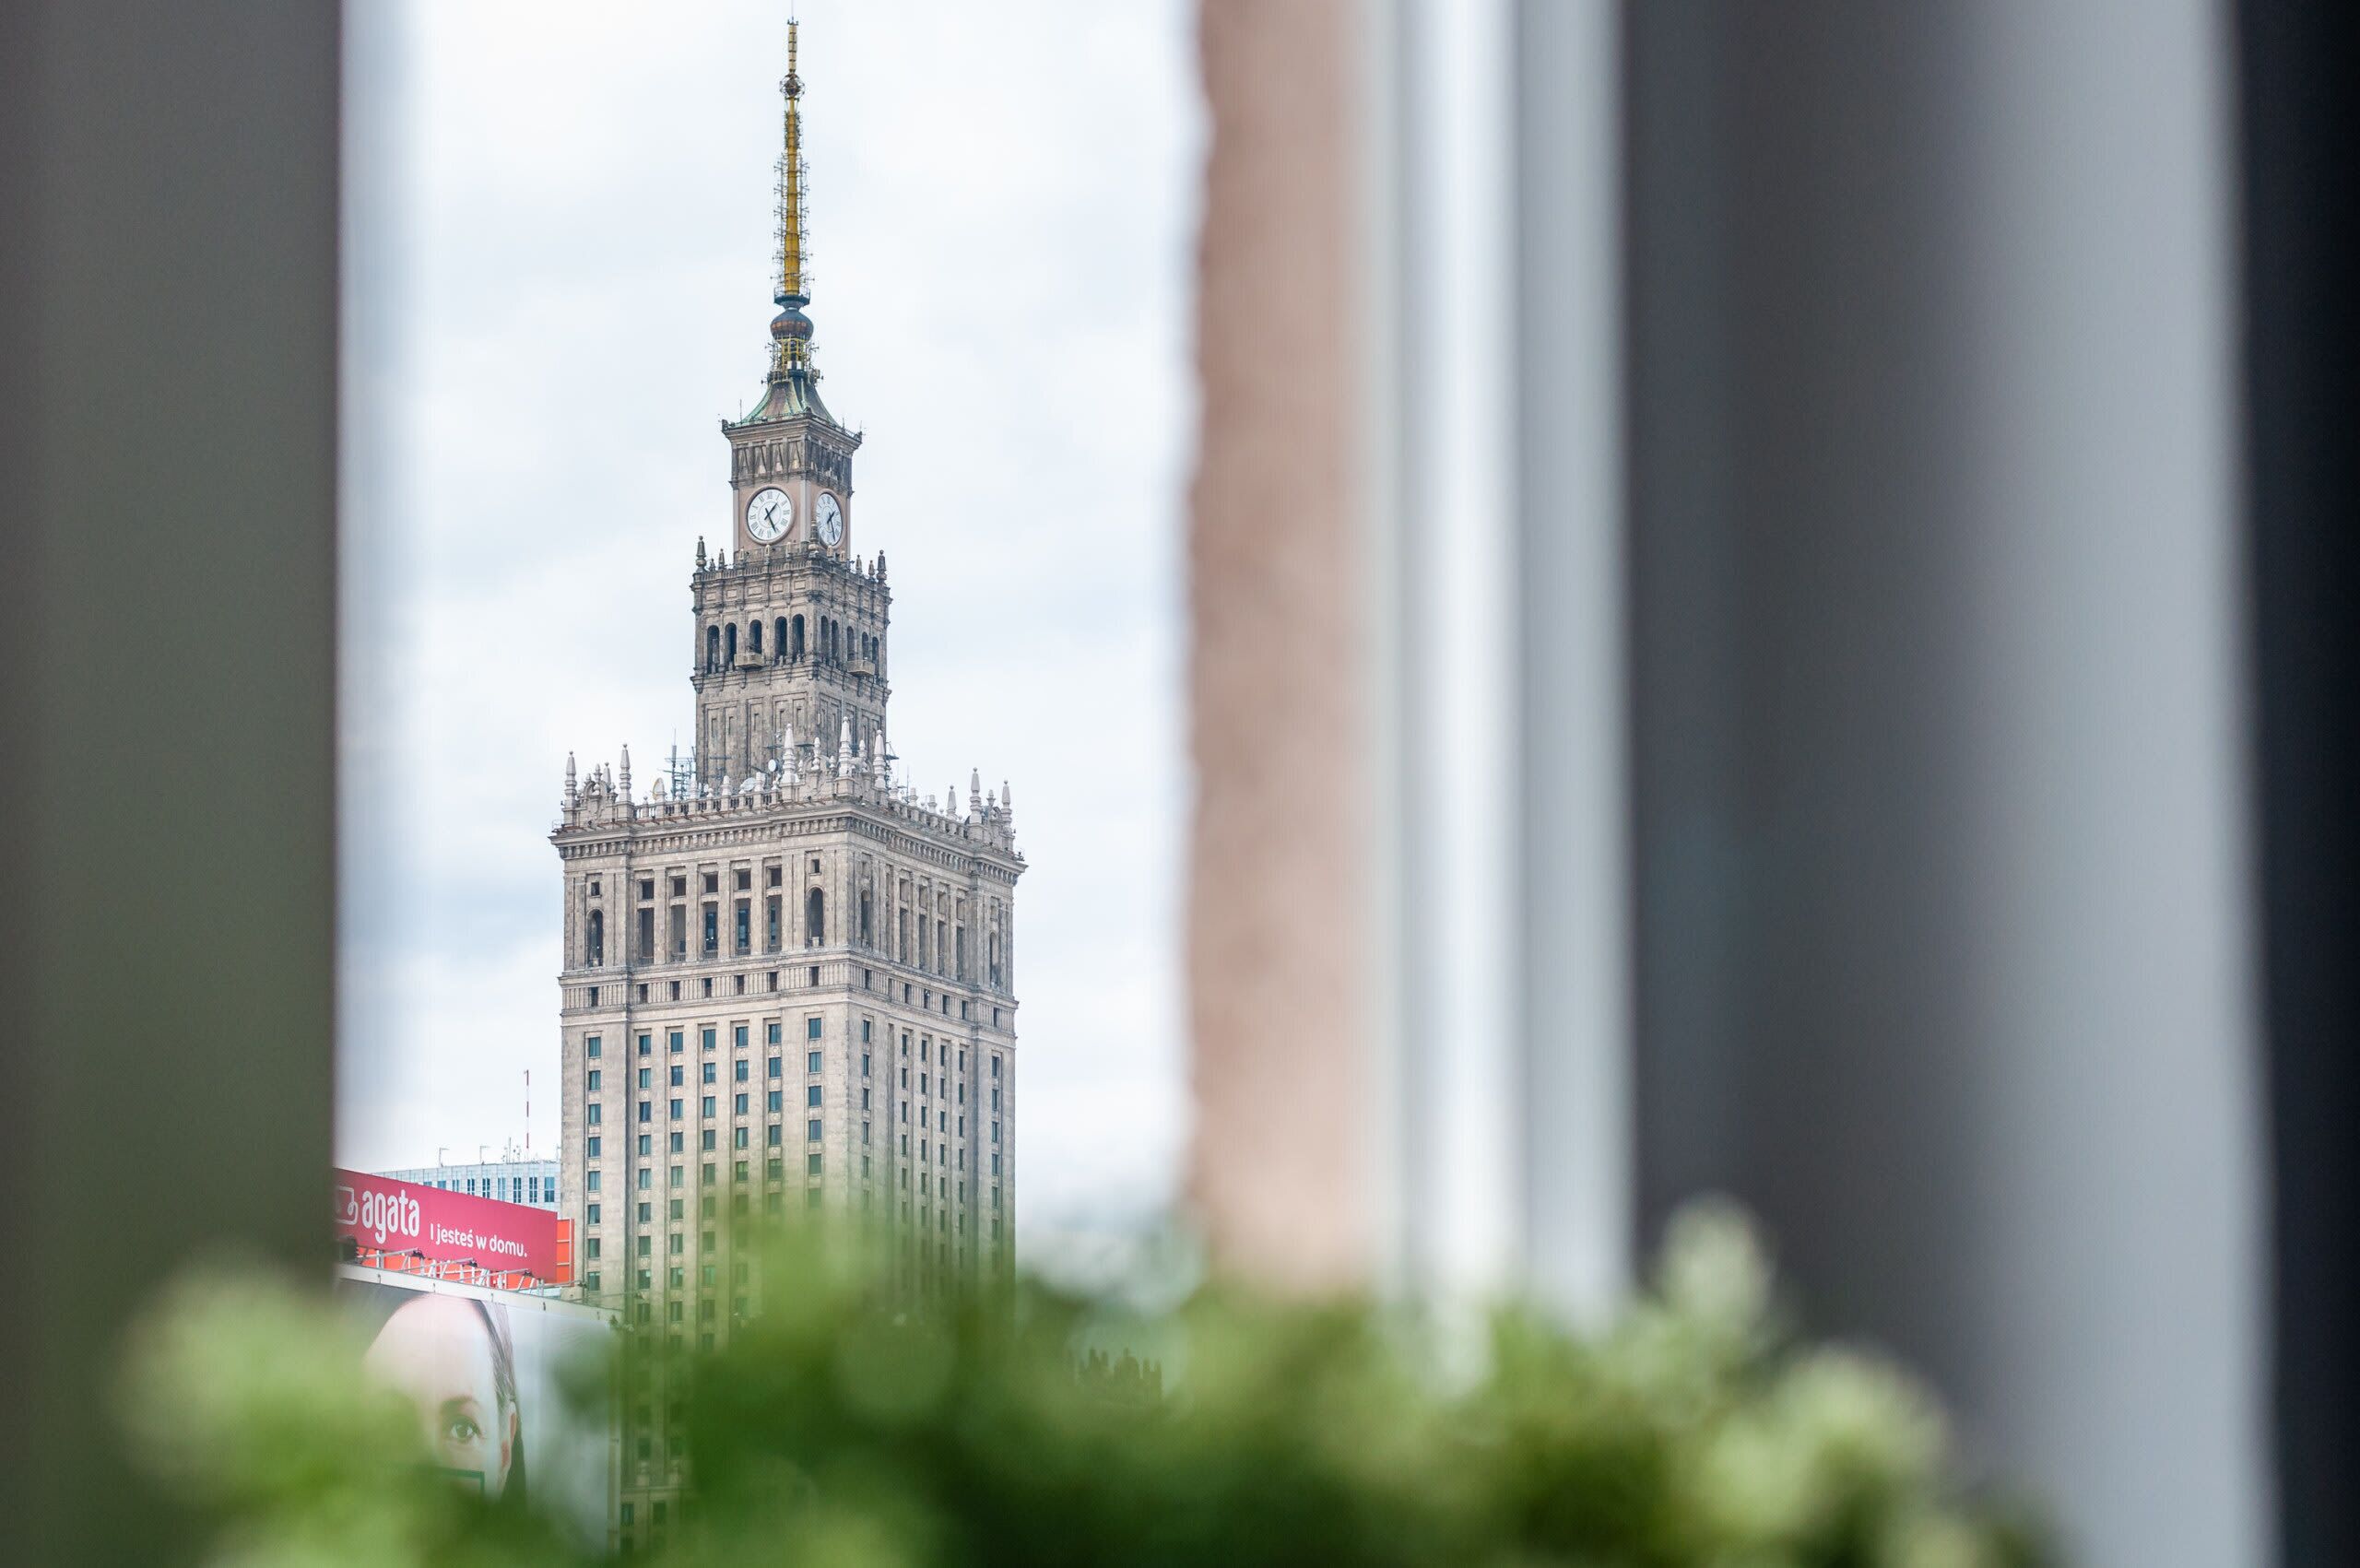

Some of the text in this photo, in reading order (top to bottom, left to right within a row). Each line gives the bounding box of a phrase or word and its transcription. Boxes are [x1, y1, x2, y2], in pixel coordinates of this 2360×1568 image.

[362, 1189, 420, 1244] agata
[430, 1222, 527, 1258] I jesteś w domu.
